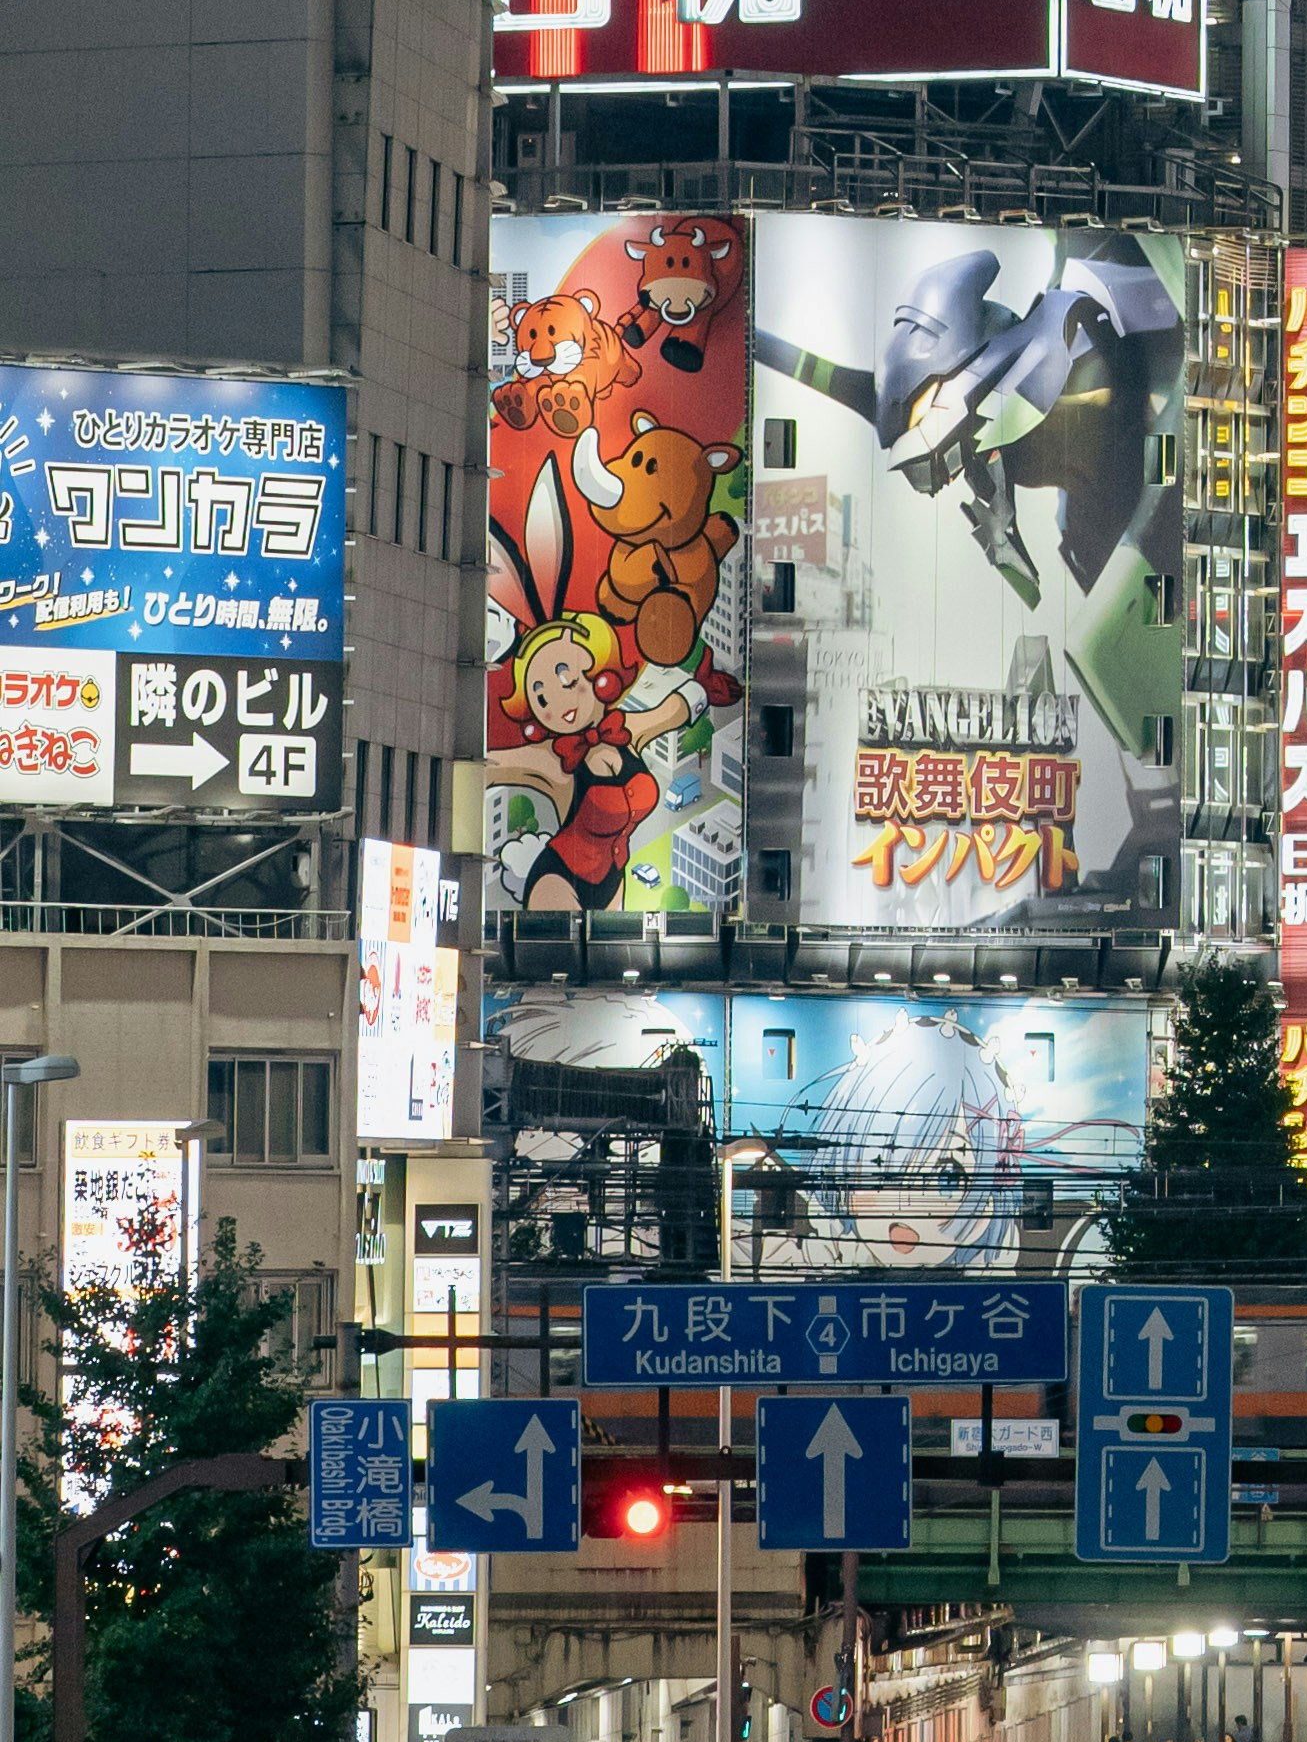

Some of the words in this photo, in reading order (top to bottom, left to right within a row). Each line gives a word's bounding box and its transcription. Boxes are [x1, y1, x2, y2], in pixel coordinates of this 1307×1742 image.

[73, 408, 325, 462] ひとりカラオケ専門店
[44, 461, 327, 560] ワンカラ
[756, 507, 826, 539] エスパス
[0, 673, 80, 710] ラオケ
[130, 662, 329, 731] 隣のビル
[857, 686, 1080, 748] EVANGELION
[247, 744, 307, 788] 4F
[856, 749, 1081, 820] 歌舞伎町
[851, 819, 1080, 890] インパクト
[622, 1293, 795, 1345] 九段下
[818, 1324, 836, 1346] 4
[636, 1349, 782, 1375] Kudanshita
[890, 1347, 999, 1377] Ichigaya
[319, 1406, 338, 1482] Otakibashi
[354, 1408, 403, 1540] 小滝橋
[319, 1486, 338, 1542] Brdg.
[414, 1613, 471, 1631] Kaleido
